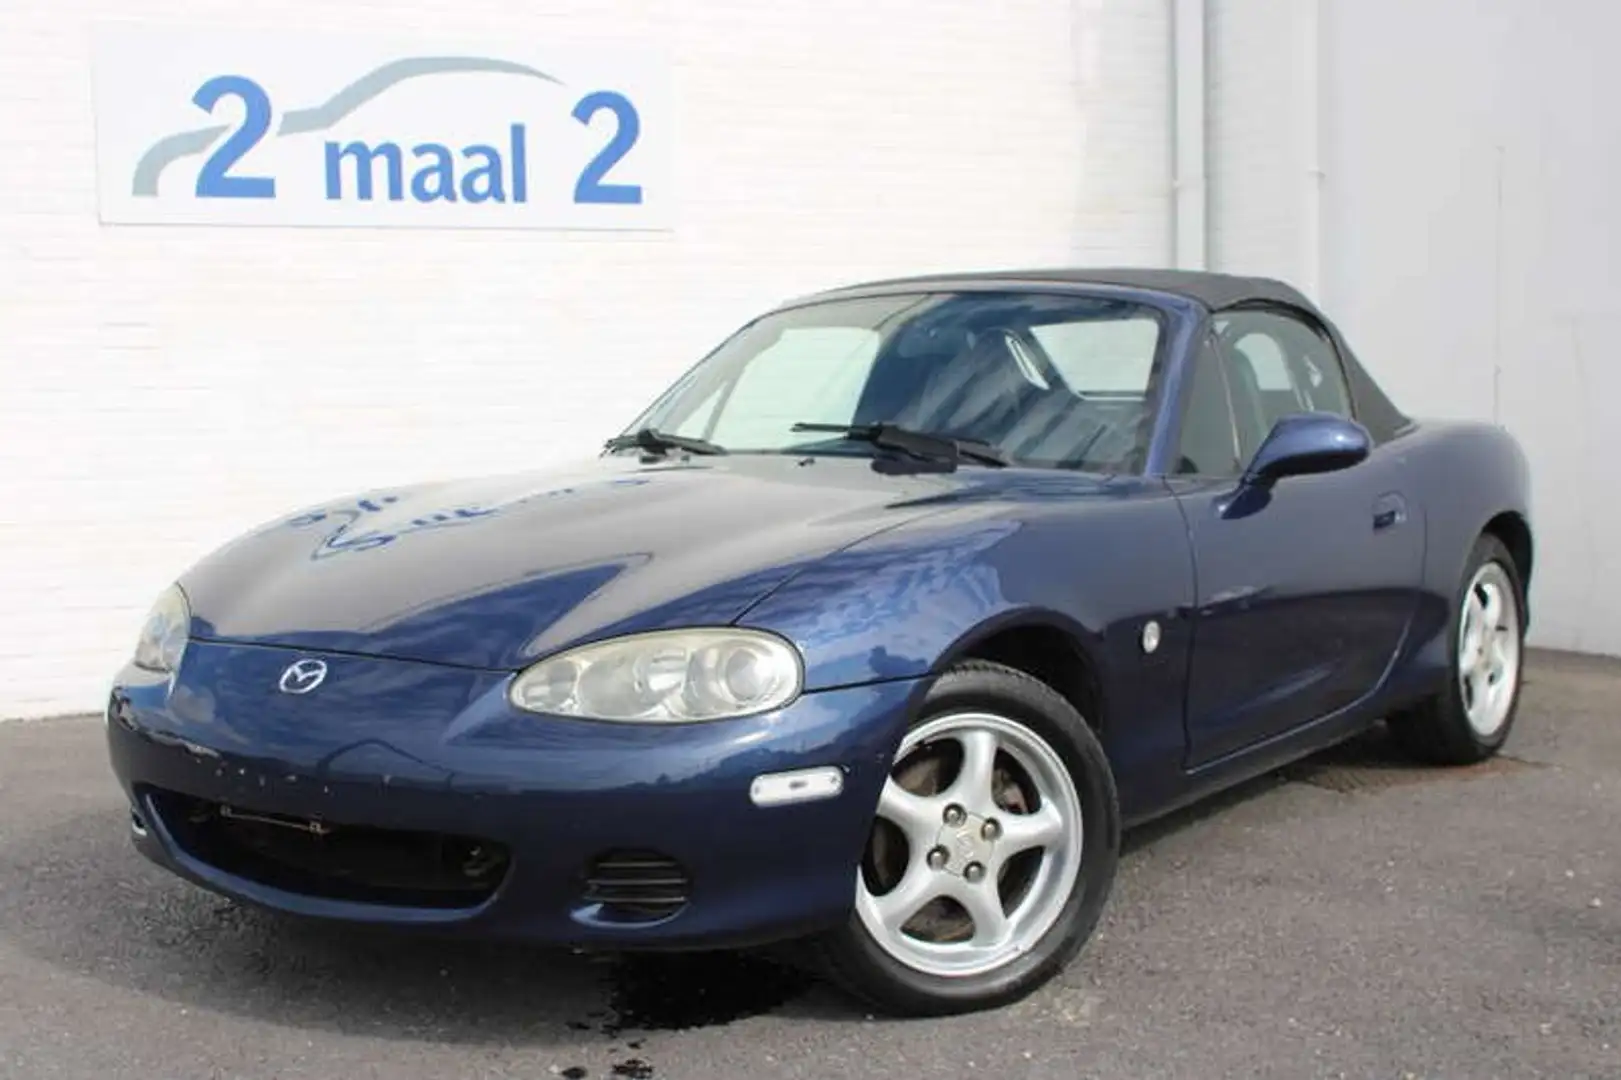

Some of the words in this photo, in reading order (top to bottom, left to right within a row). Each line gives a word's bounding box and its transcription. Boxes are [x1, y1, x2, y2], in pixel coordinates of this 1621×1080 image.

[193, 75, 276, 199] 2
[324, 124, 527, 203] maal
[572, 90, 642, 204] 2
